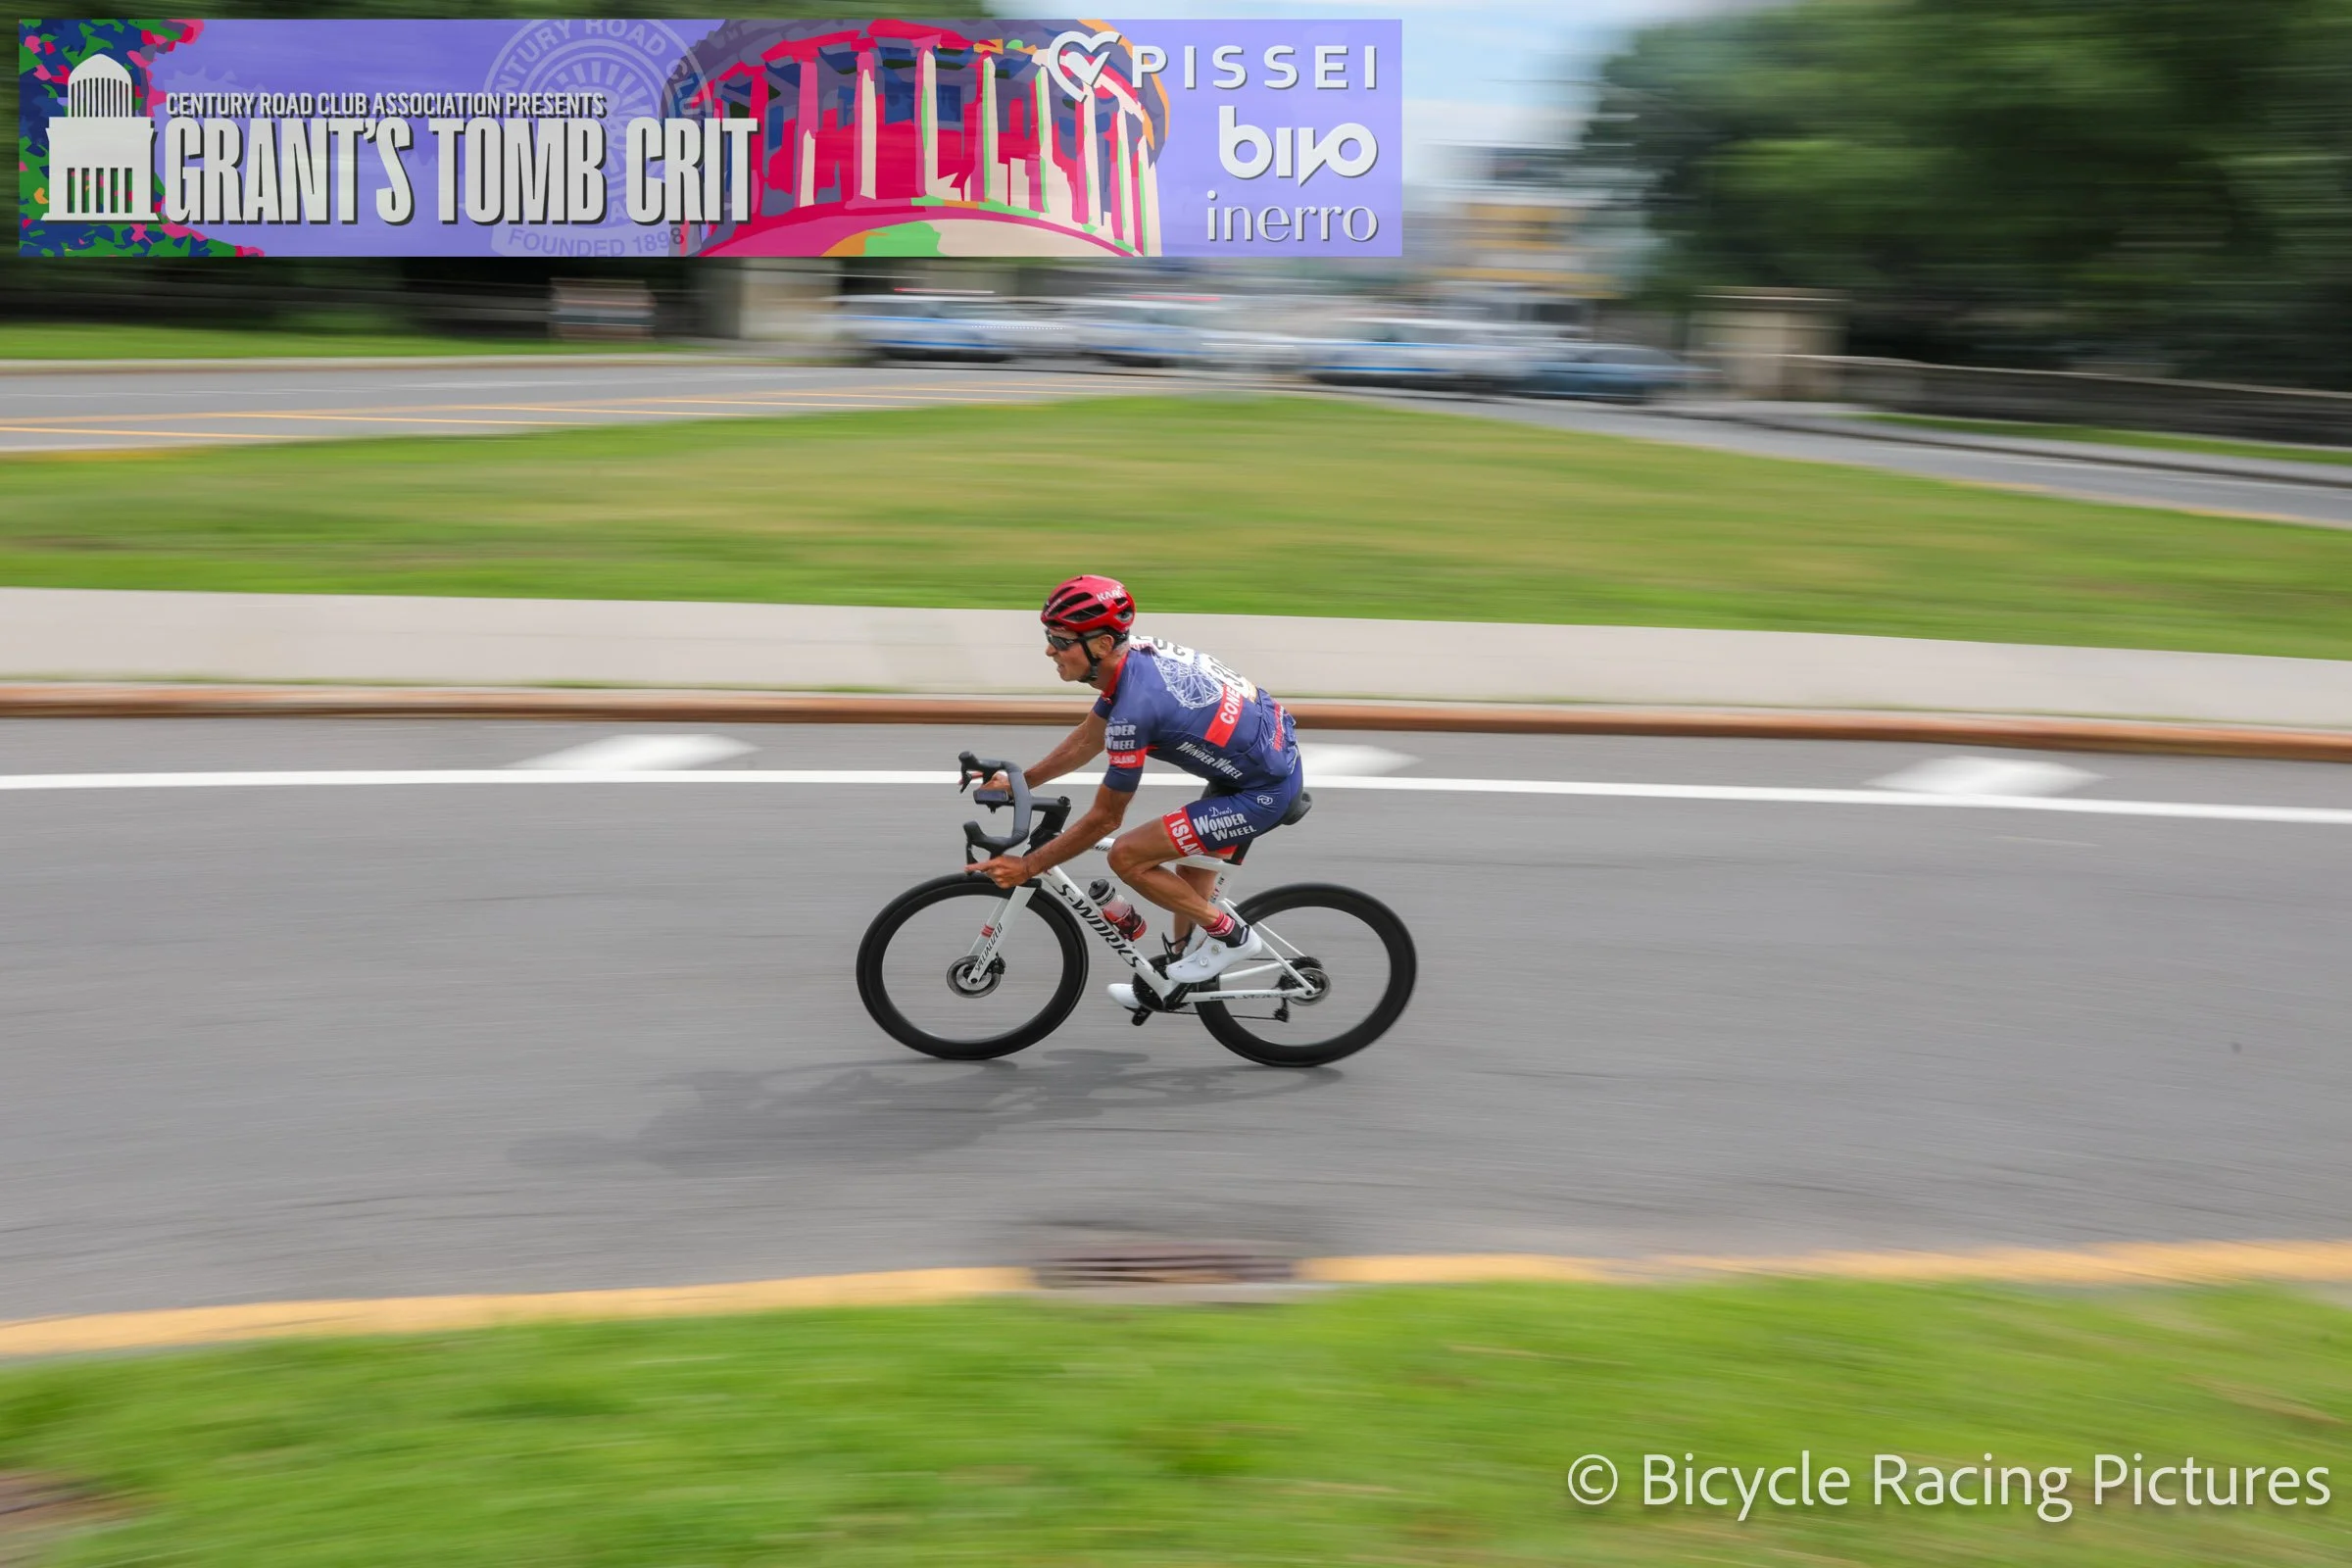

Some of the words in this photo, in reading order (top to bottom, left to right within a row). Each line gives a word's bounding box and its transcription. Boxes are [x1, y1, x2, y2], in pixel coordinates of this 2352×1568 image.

[1193, 812, 1247, 836] WONDER
[1211, 824, 1256, 842] WHEEL
[1052, 884, 1146, 968] S-WORKS
